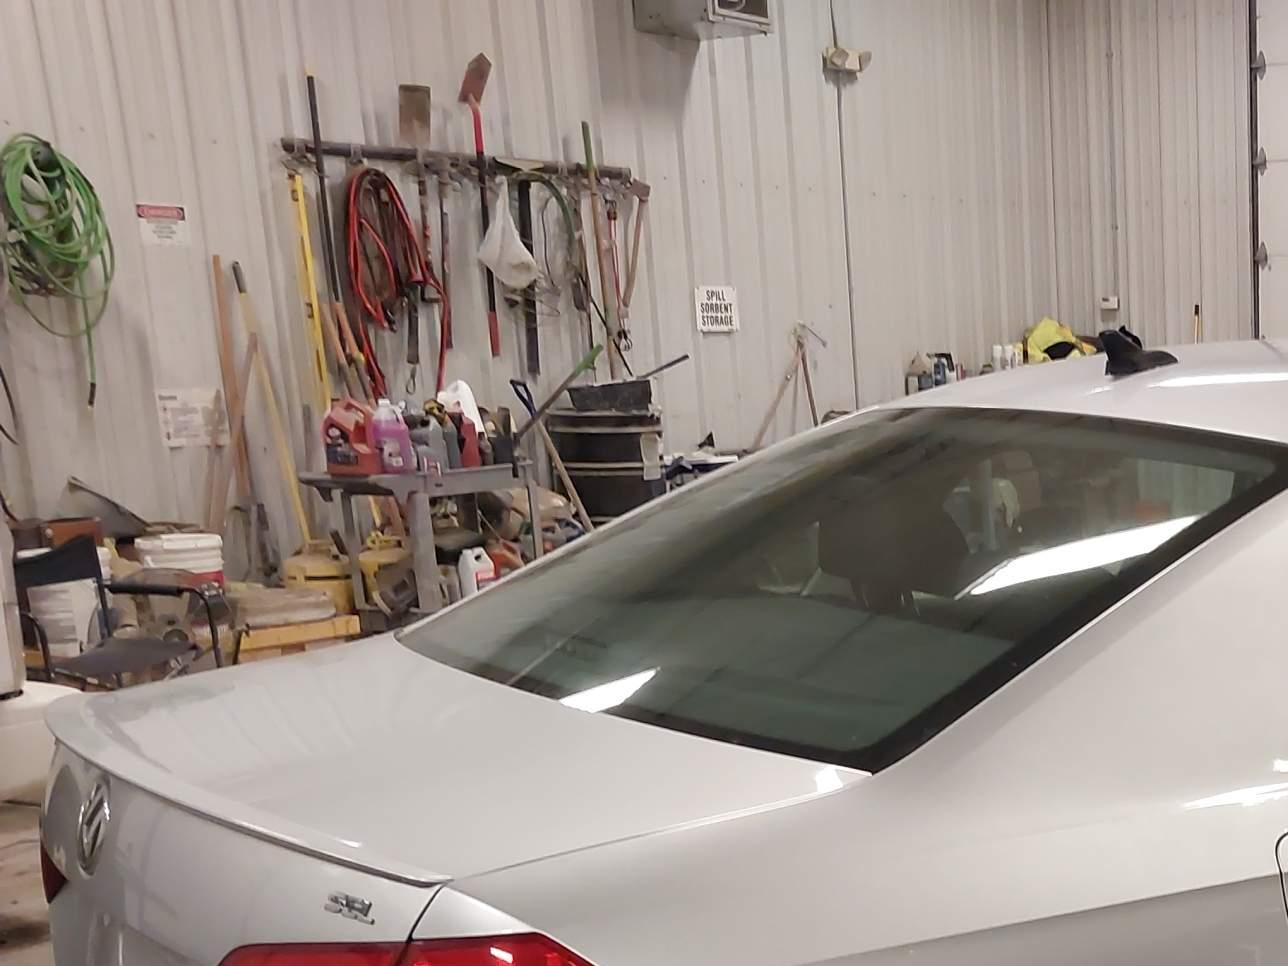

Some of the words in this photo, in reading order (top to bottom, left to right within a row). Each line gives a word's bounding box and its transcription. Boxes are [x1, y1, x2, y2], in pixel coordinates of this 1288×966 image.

[706, 290, 726, 301] SPILL
[700, 302, 732, 314] SORBENT
[701, 315, 734, 327] STORAGE
